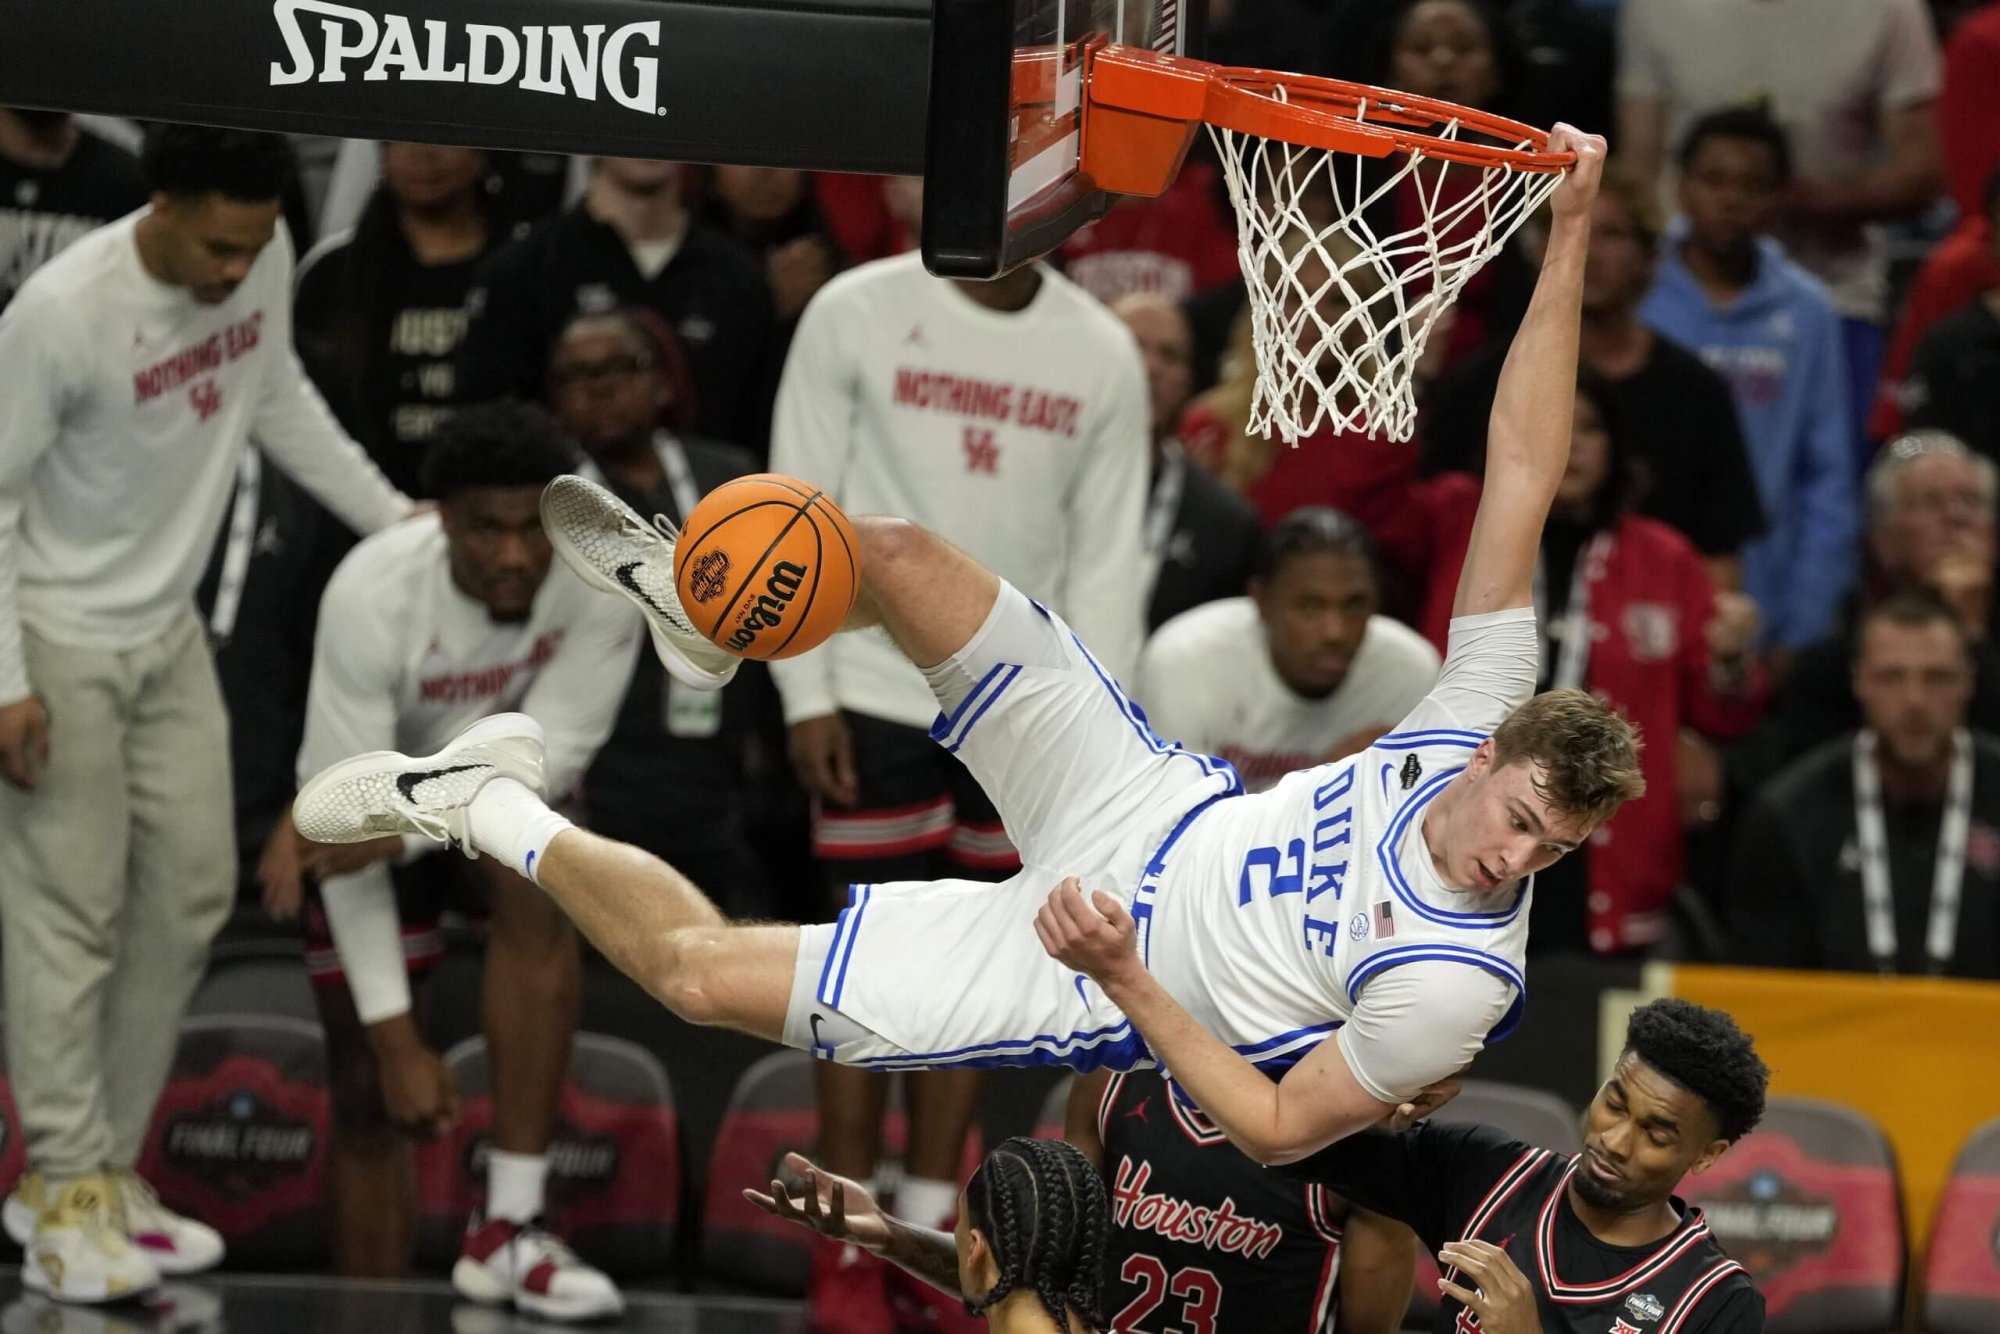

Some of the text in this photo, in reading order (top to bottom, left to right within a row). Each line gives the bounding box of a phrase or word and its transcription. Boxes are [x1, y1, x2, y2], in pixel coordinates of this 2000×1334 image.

[270, 0, 660, 115] SPALDING
[894, 367, 1011, 421] NOTHING
[724, 560, 807, 652] Wilson
[735, 594, 756, 624] EVO NXT
[1239, 837, 1305, 908] 2
[1303, 763, 1355, 958] DUKE
[1112, 1154, 1282, 1260] Houston
[1110, 1252, 1223, 1334] 23
[1629, 1297, 1662, 1316] FINAL FOUR
